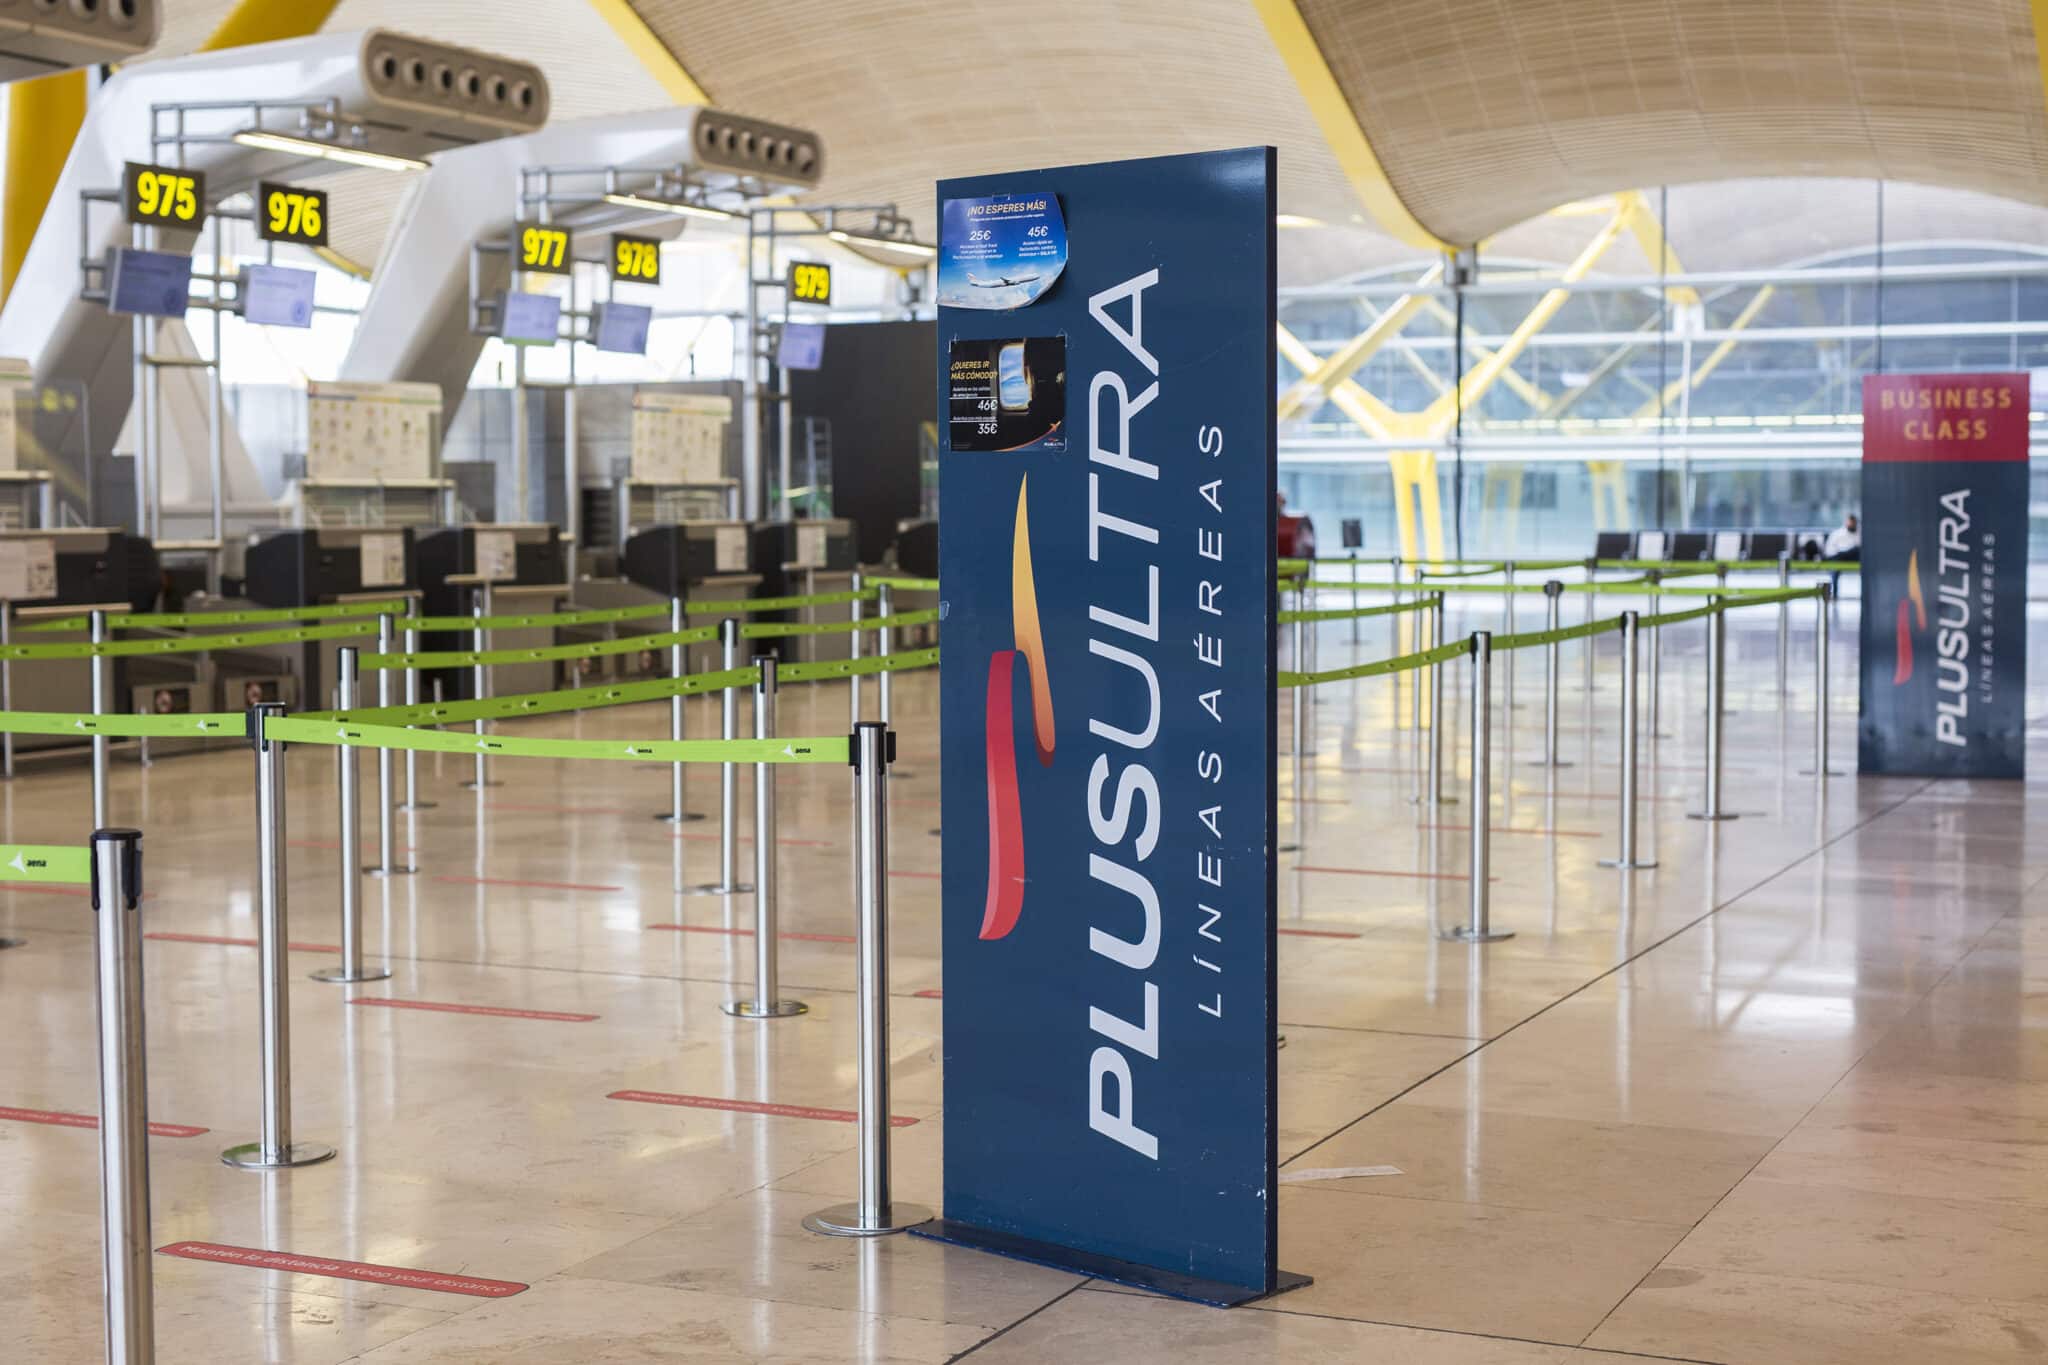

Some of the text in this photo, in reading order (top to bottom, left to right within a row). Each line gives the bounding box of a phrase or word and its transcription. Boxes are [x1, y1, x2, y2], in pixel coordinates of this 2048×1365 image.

[137, 171, 196, 220] 975
[967, 199, 1047, 217] ¡NO ESPERES MÁS!
[268, 192, 321, 237] 976
[969, 229, 992, 241] 25€
[1027, 226, 1048, 237] 45€
[523, 228, 567, 267] 977
[616, 240, 657, 278] 978
[794, 265, 829, 299] 979
[977, 400, 998, 411] 46€
[1881, 387, 2012, 410] BUSINESS
[977, 423, 998, 435] 35€
[1904, 419, 1987, 441] CLASS
[1936, 489, 1971, 747] PLUSULTRA
[1087, 268, 1162, 1160] PLUSULTRA
[1193, 424, 1223, 1018] LÍNEAS AÉREAS
[26, 859, 48, 867] aena
